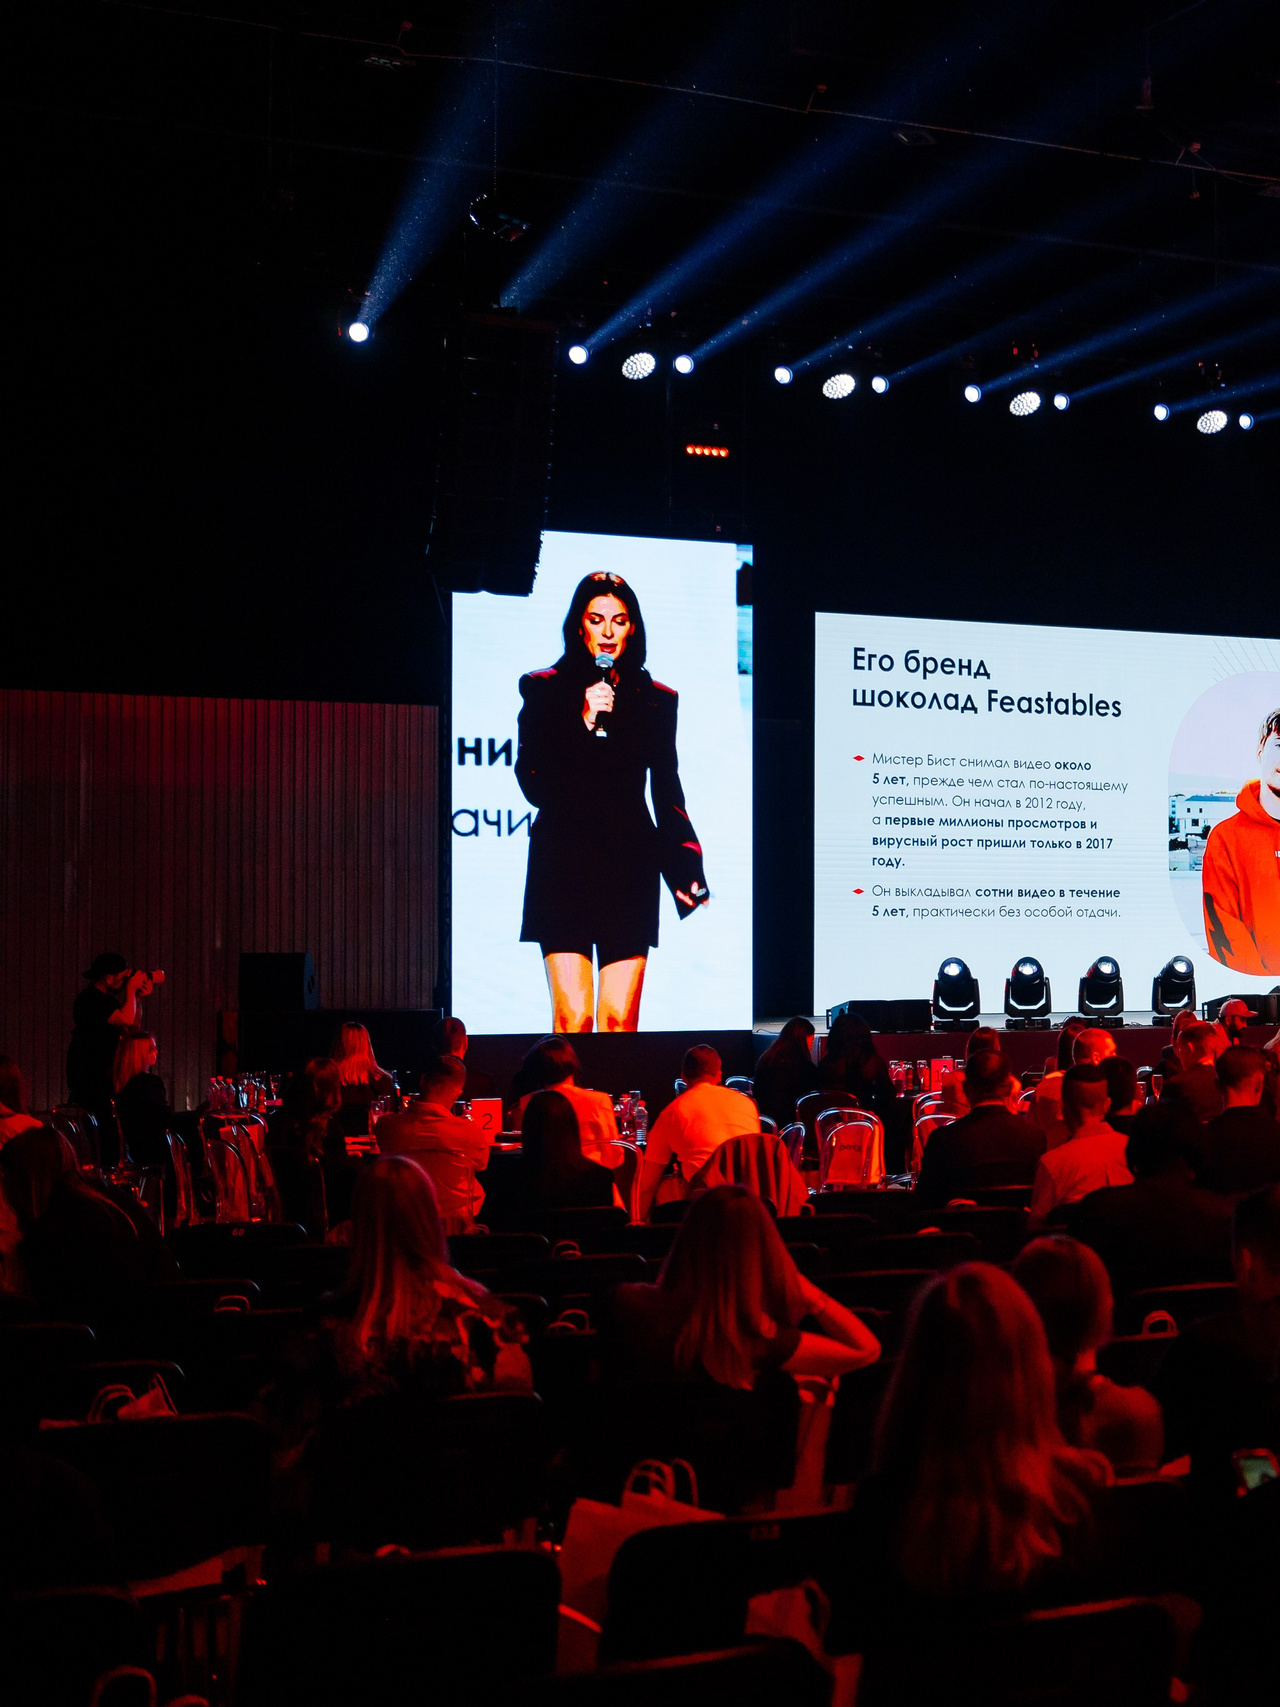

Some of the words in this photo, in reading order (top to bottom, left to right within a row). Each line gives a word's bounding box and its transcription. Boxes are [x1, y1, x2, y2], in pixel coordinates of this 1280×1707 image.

[853, 647, 895, 672] Его
[904, 649, 991, 680] бренд
[852, 688, 978, 714] шоколад
[987, 689, 1122, 718] Feastables
[457, 737, 512, 766] ни
[872, 753, 924, 767] Мистер
[927, 754, 956, 767] Бист
[959, 757, 1010, 769] снимал
[1013, 759, 1051, 771] видео
[1054, 760, 1092, 771] около
[872, 773, 880, 785] 5
[883, 774, 910, 787] лет,
[913, 775, 964, 789] прежде
[968, 777, 994, 788] чем
[997, 779, 1026, 789] стал
[1029, 779, 1128, 795] по-настоящему
[872, 795, 948, 809] успешным.
[952, 795, 970, 808] Он
[974, 797, 1012, 809] начал
[1015, 799, 1021, 809] в
[1025, 797, 1053, 809] 2012
[1056, 799, 1086, 812] году,
[872, 815, 881, 826] а
[885, 816, 935, 829] первые
[939, 817, 1004, 829] миллионы
[1008, 819, 1086, 832] просмотров
[1090, 820, 1097, 830] и
[872, 835, 937, 849] вирусный
[941, 838, 973, 850] рост
[977, 839, 1026, 851] пришли
[1030, 840, 1072, 851] только
[1076, 840, 1082, 850] в
[1086, 837, 1113, 850] 2017
[872, 856, 905, 869] году.
[872, 884, 891, 898] Он
[895, 887, 971, 900] выкладывал
[975, 887, 1013, 899] сотни
[1017, 887, 1055, 900] видео
[1059, 888, 1065, 899] в
[1069, 888, 1121, 899] течение
[872, 905, 880, 917] 5
[883, 907, 910, 920] лет,
[913, 907, 995, 920] практически
[999, 905, 1021, 918] без
[1024, 905, 1073, 918] особой
[1076, 907, 1121, 920] отдачи.
[482, 1113, 493, 1130] 2
